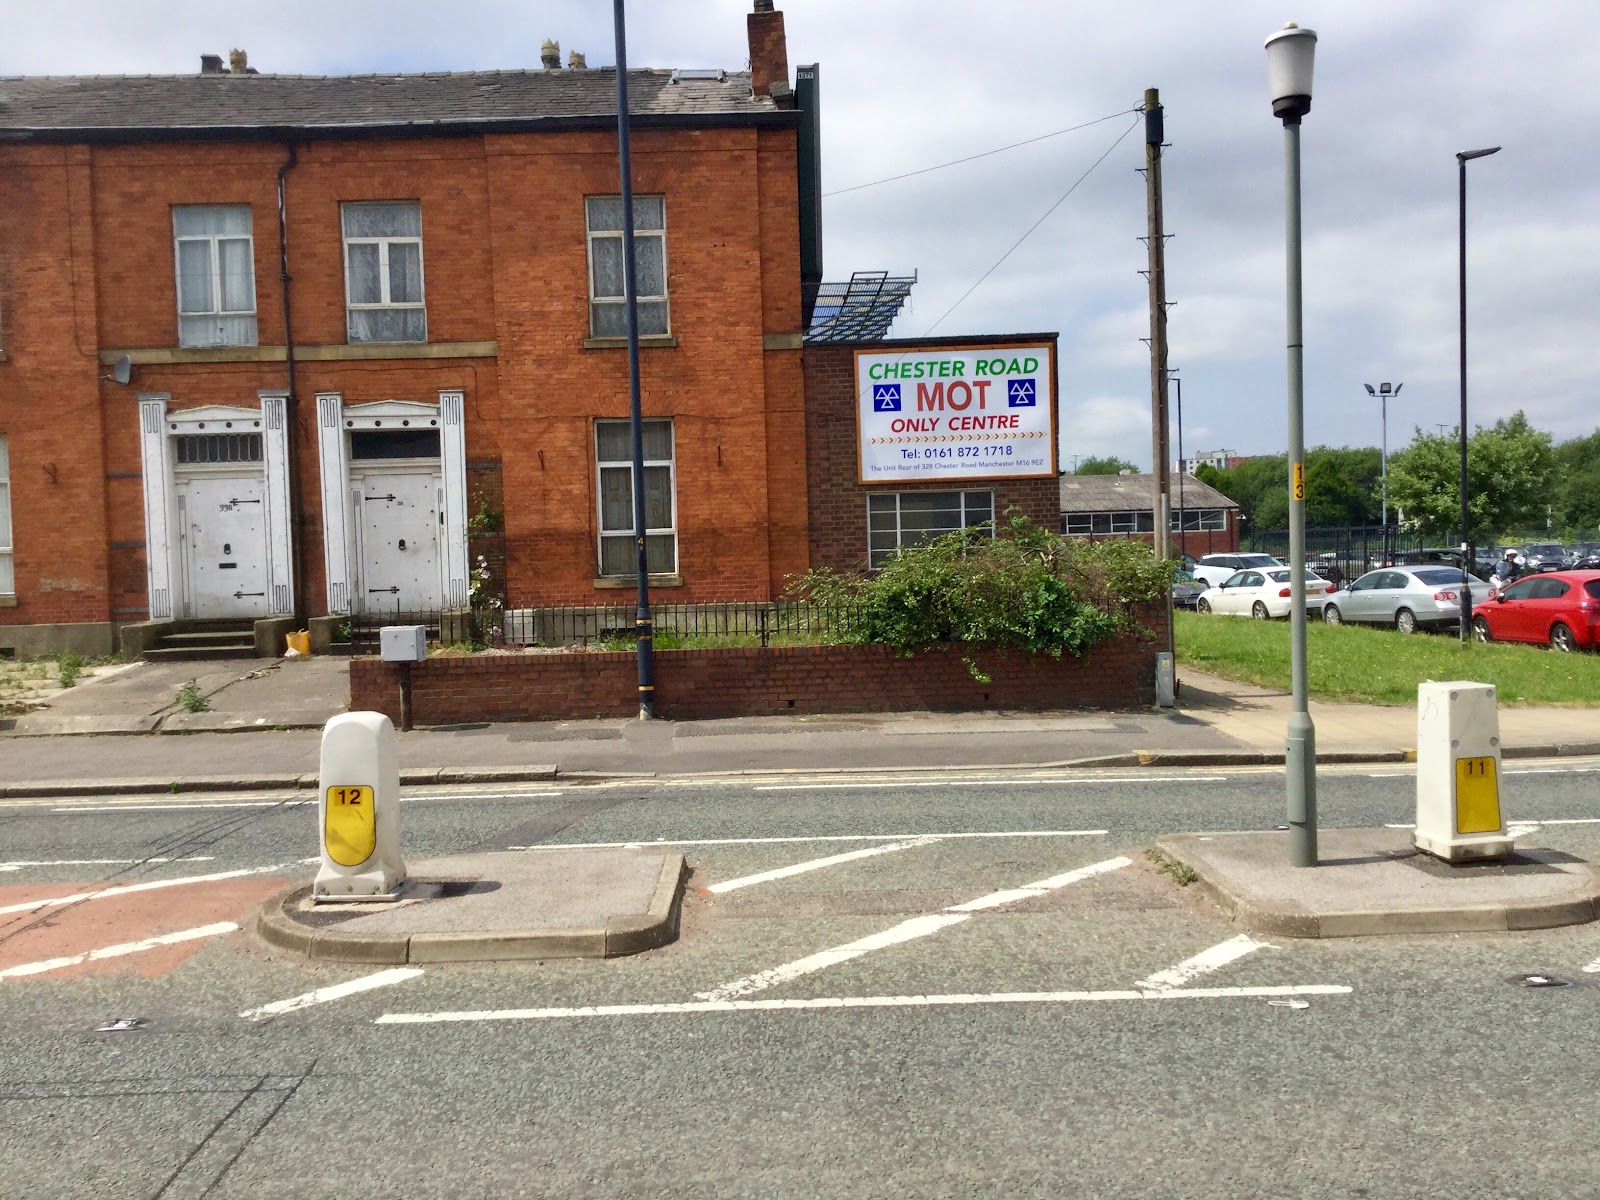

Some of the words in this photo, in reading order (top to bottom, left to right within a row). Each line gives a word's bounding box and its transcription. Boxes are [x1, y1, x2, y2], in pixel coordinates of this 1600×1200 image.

[868, 360, 965, 380] CHESTER
[975, 357, 1039, 376] ROAD
[917, 380, 991, 412] MOT
[891, 417, 941, 433] ONLY
[948, 414, 1020, 431] CENTRE
[901, 448, 921, 459] Tel:
[924, 447, 952, 458] 0161
[957, 446, 980, 457] 872
[984, 445, 1013, 456] 1718
[883, 464, 896, 472] Unit
[978, 460, 1015, 468] Manchester
[1031, 458, 1044, 466] 9EZ
[1467, 760, 1485, 775] 11
[338, 789, 361, 805] 12
